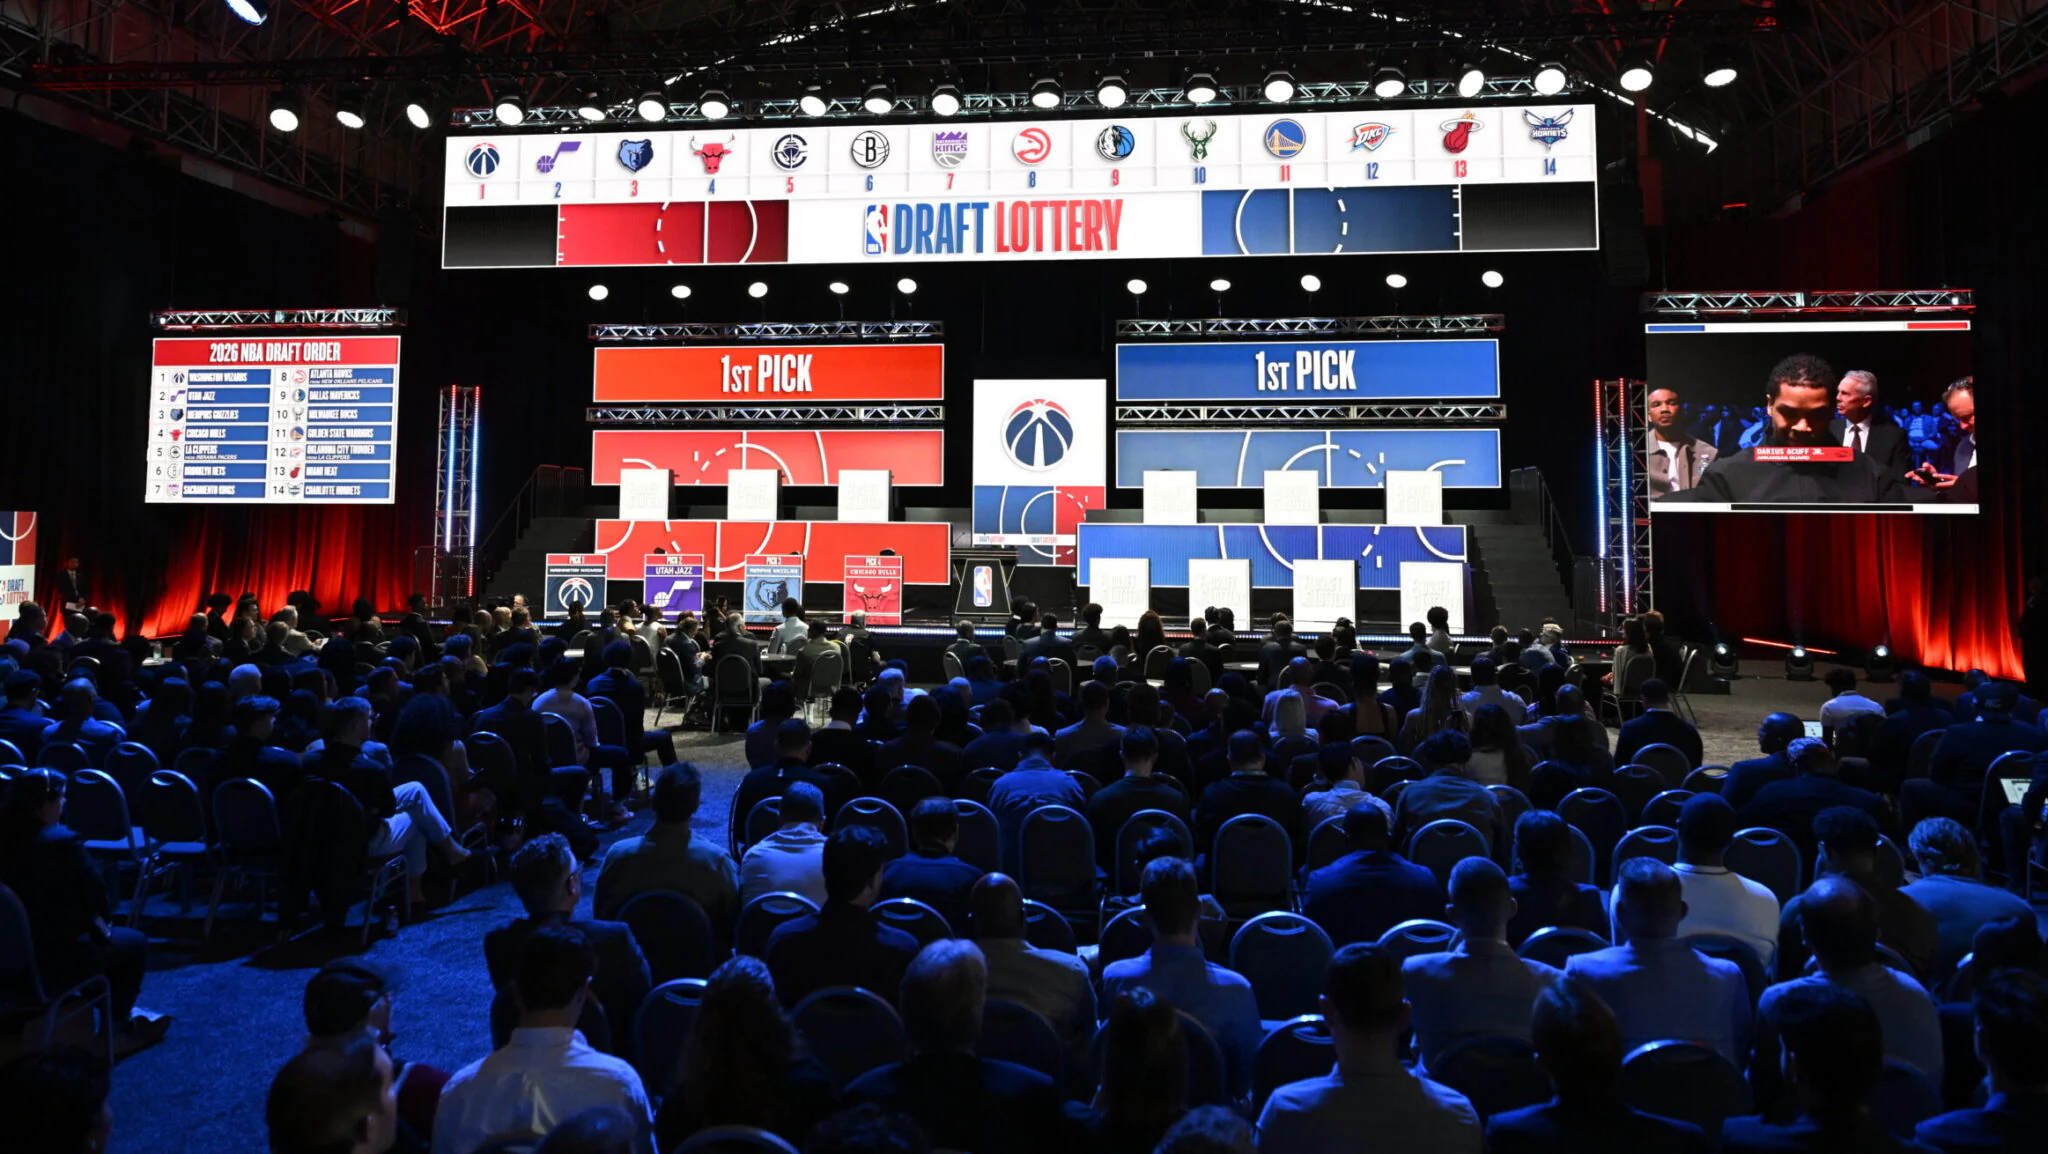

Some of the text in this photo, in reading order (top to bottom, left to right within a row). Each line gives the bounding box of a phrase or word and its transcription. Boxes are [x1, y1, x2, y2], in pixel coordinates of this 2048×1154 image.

[1354, 128, 1383, 146] OKC
[1532, 129, 1567, 138] HORNETS
[865, 137, 876, 162] B
[935, 144, 968, 152] KINGS
[1367, 163, 1378, 180] 12
[1455, 160, 1467, 177] 13
[1543, 158, 1556, 175] 14
[1029, 172, 1036, 187] 8
[1111, 169, 1119, 186] 9
[1193, 167, 1206, 184] 10
[1280, 165, 1290, 182] 11
[707, 179, 715, 194] 4
[786, 177, 794, 193] 5
[866, 175, 873, 191] 6
[947, 173, 954, 189] 7
[480, 184, 485, 198] 1
[554, 182, 561, 198] 2
[631, 180, 638, 196] 3
[894, 199, 1123, 255] DRAFT LOTTERY
[209, 342, 341, 362] 2026 NBA DRAFT ORDER
[281, 372, 287, 381] 8
[721, 354, 813, 393] 1ST PICK
[1255, 349, 1357, 391] 1ST PICK
[160, 373, 165, 381] 1
[160, 392, 166, 401] 2
[280, 391, 286, 400] 9
[159, 410, 165, 419] 3
[276, 410, 288, 419] 10
[158, 429, 164, 438] 4
[276, 429, 286, 438] 11
[157, 448, 163, 457] 5
[275, 448, 286, 457] 12
[156, 466, 162, 475] 6
[274, 466, 286, 476] 13
[155, 485, 161, 494] 7
[273, 486, 284, 494] 14
[569, 556, 582, 565] PICK
[666, 556, 679, 565] PICK
[766, 556, 777, 565] PICK
[865, 557, 876, 566] PICK
[655, 567, 693, 575] UTAH JAZZ
[7, 579, 24, 592] DRAFT
[6, 591, 30, 604] LOTTERY
